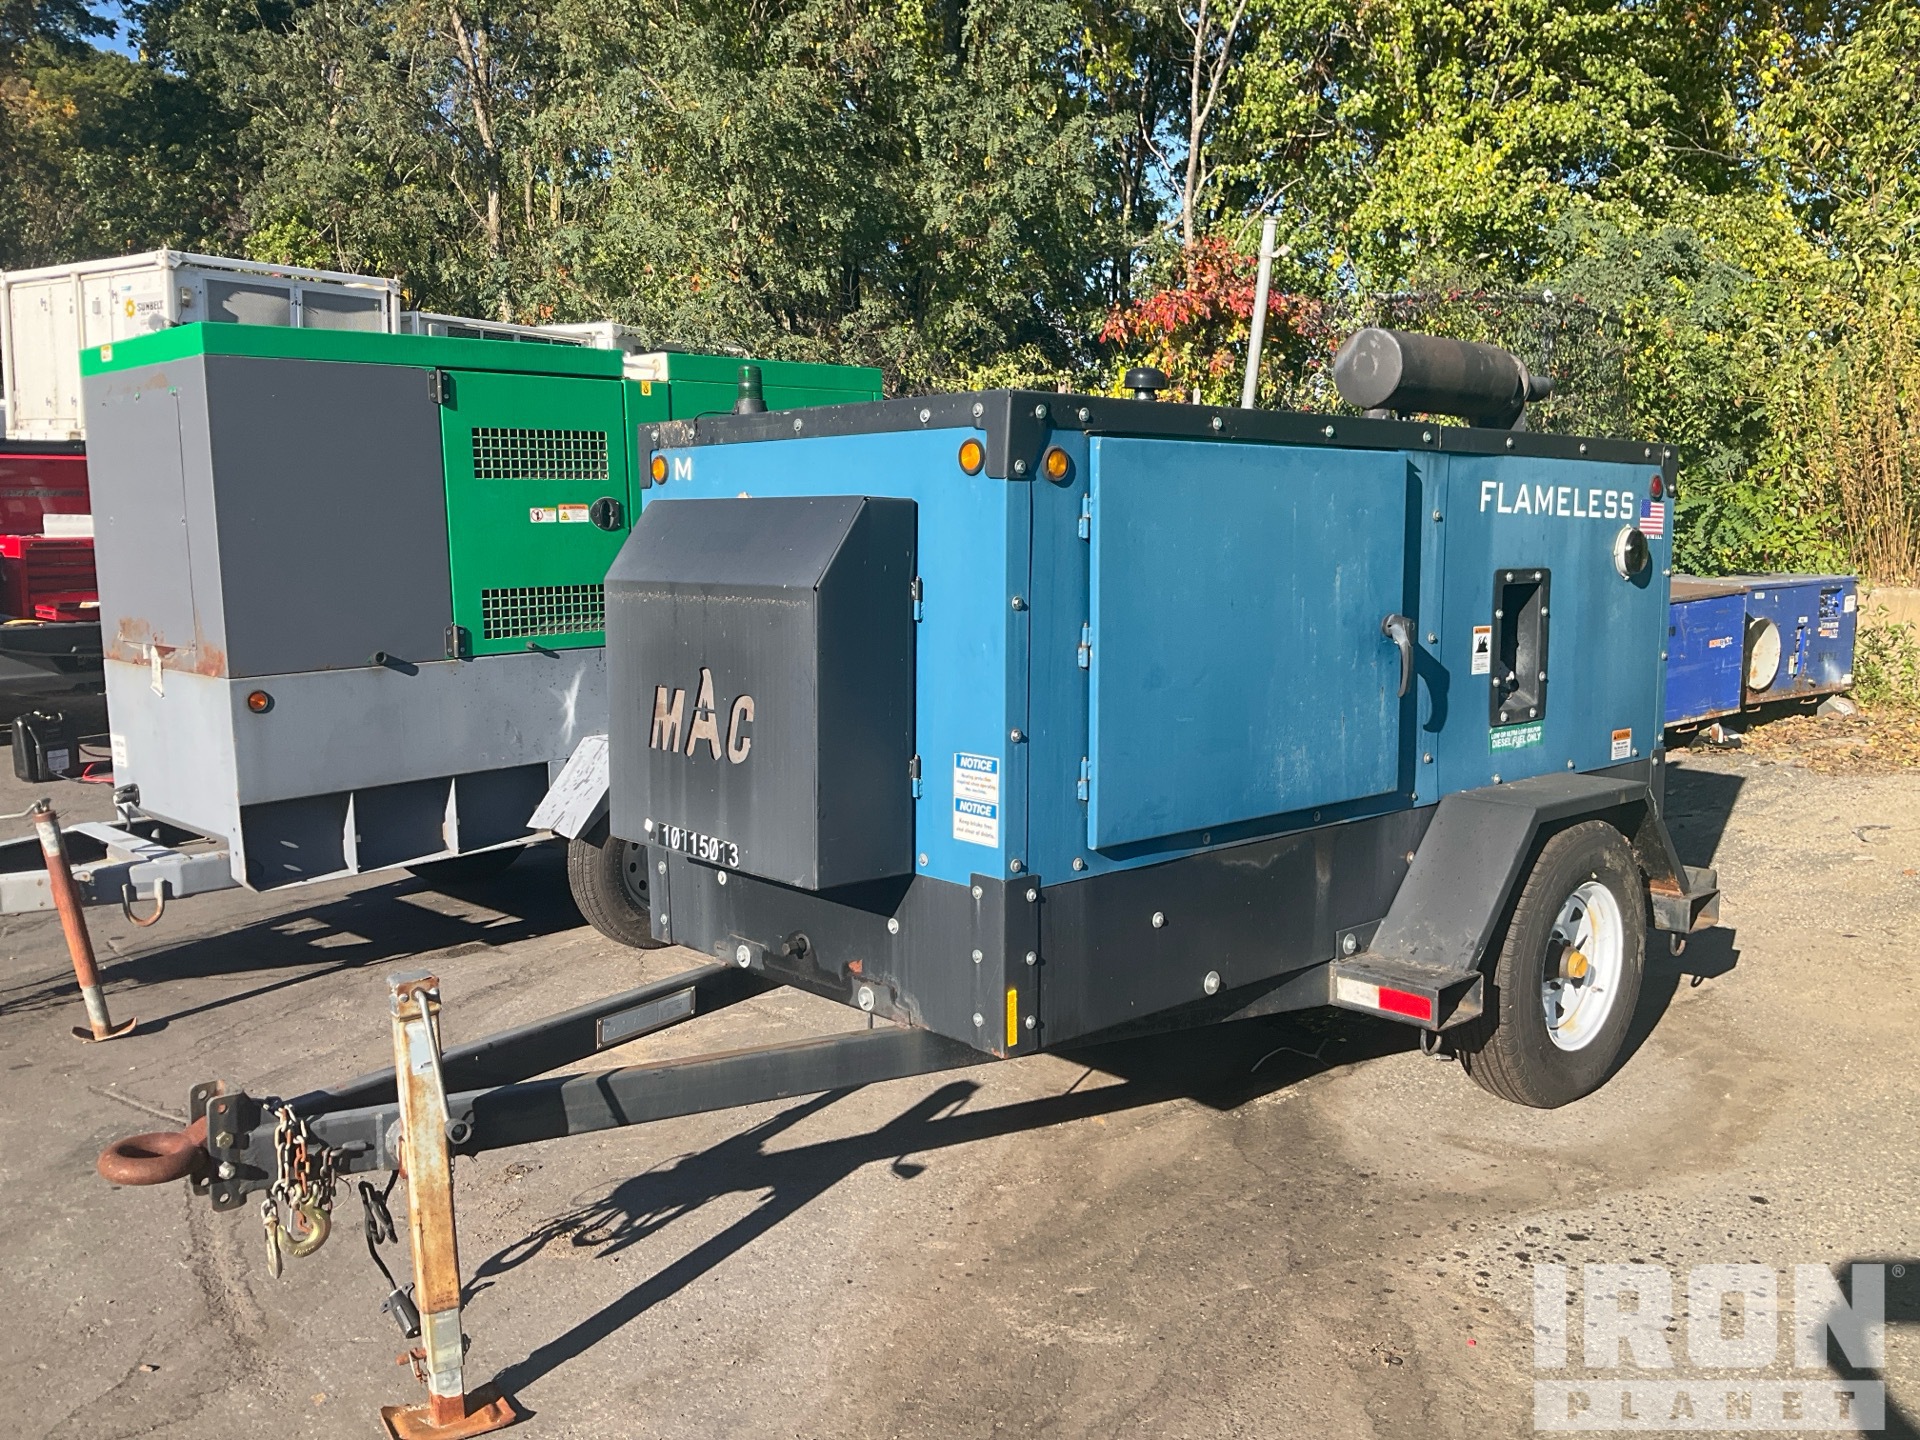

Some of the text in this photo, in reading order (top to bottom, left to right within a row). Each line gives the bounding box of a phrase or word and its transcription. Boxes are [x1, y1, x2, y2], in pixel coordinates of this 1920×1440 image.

[136, 300, 163, 311] SUNBELT
[675, 456, 692, 481] M
[1480, 480, 1634, 520] FLAMELESS
[649, 667, 755, 764] MAC
[1492, 737, 1512, 749] DIESEL
[1527, 732, 1542, 742] ONLY
[960, 756, 993, 771] NOTICE
[960, 800, 993, 816] NOTICE
[662, 824, 739, 868] 10115013
